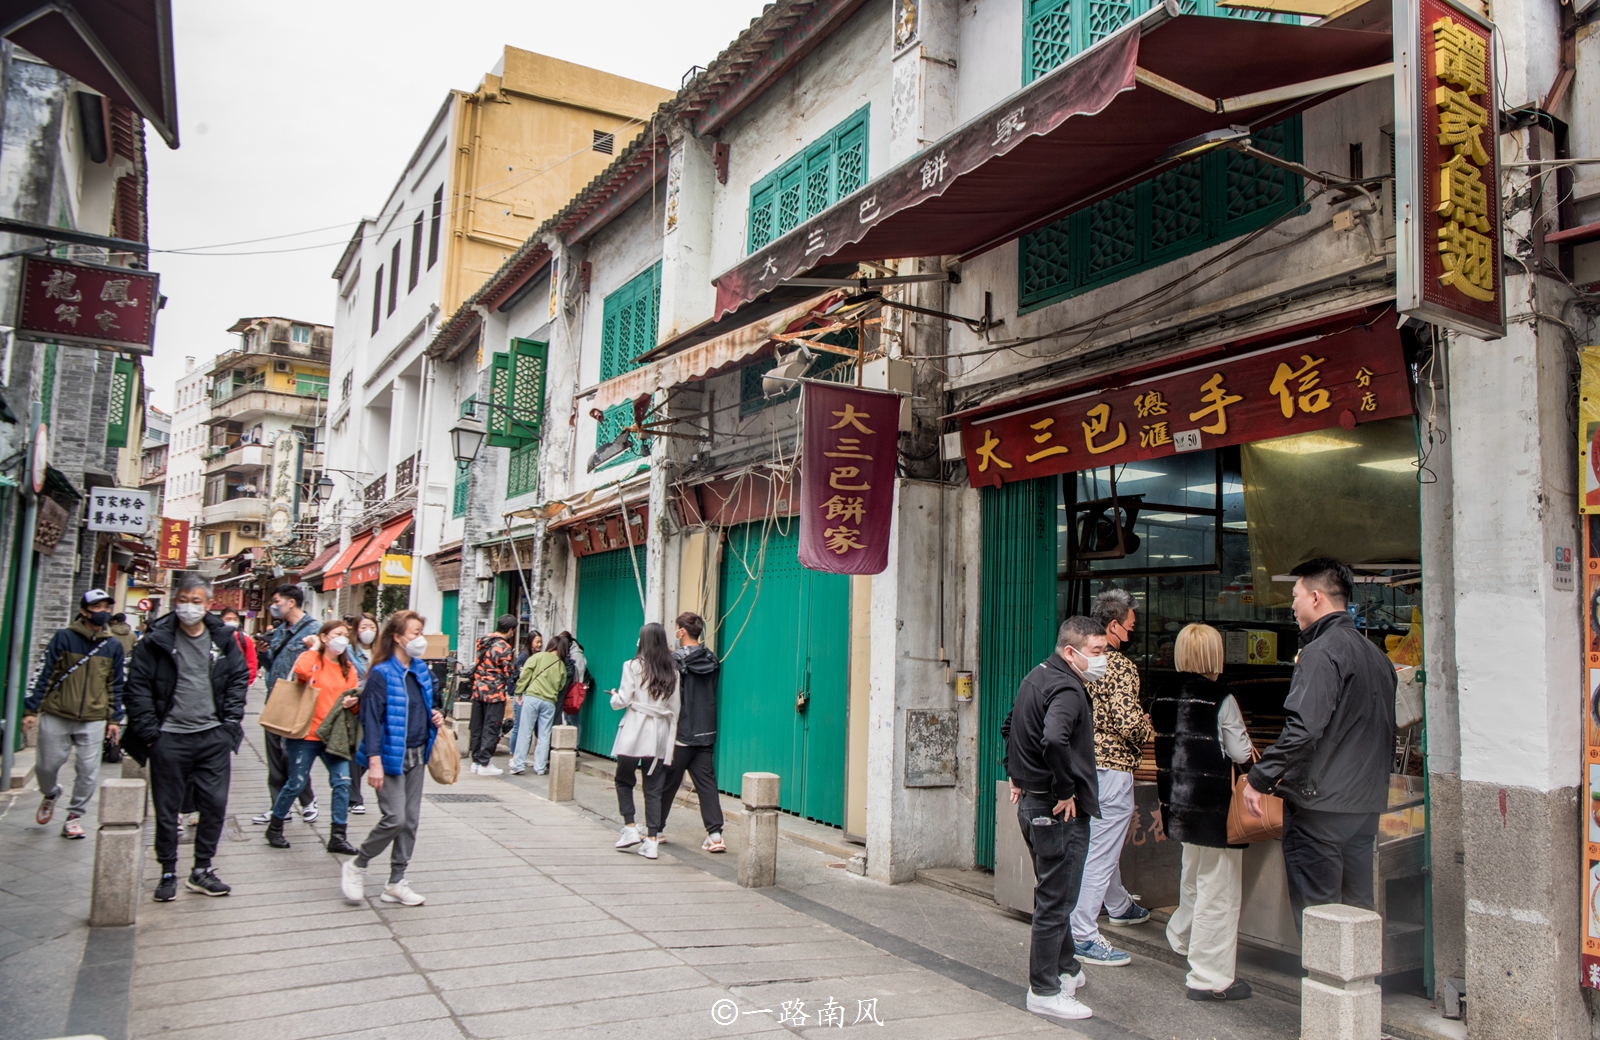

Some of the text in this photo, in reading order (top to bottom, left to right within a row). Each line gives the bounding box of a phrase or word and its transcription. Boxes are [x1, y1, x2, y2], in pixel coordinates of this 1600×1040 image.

[759, 106, 1026, 281] 大三巴餅家
[1432, 16, 1494, 302] 譚家魚翅
[1355, 366, 1377, 412] 分店
[975, 402, 1128, 473] 大三巴
[1188, 433, 1198, 447] 50
[94, 495, 145, 510] 百家綜合
[819, 403, 876, 555] 大三巴餅家
